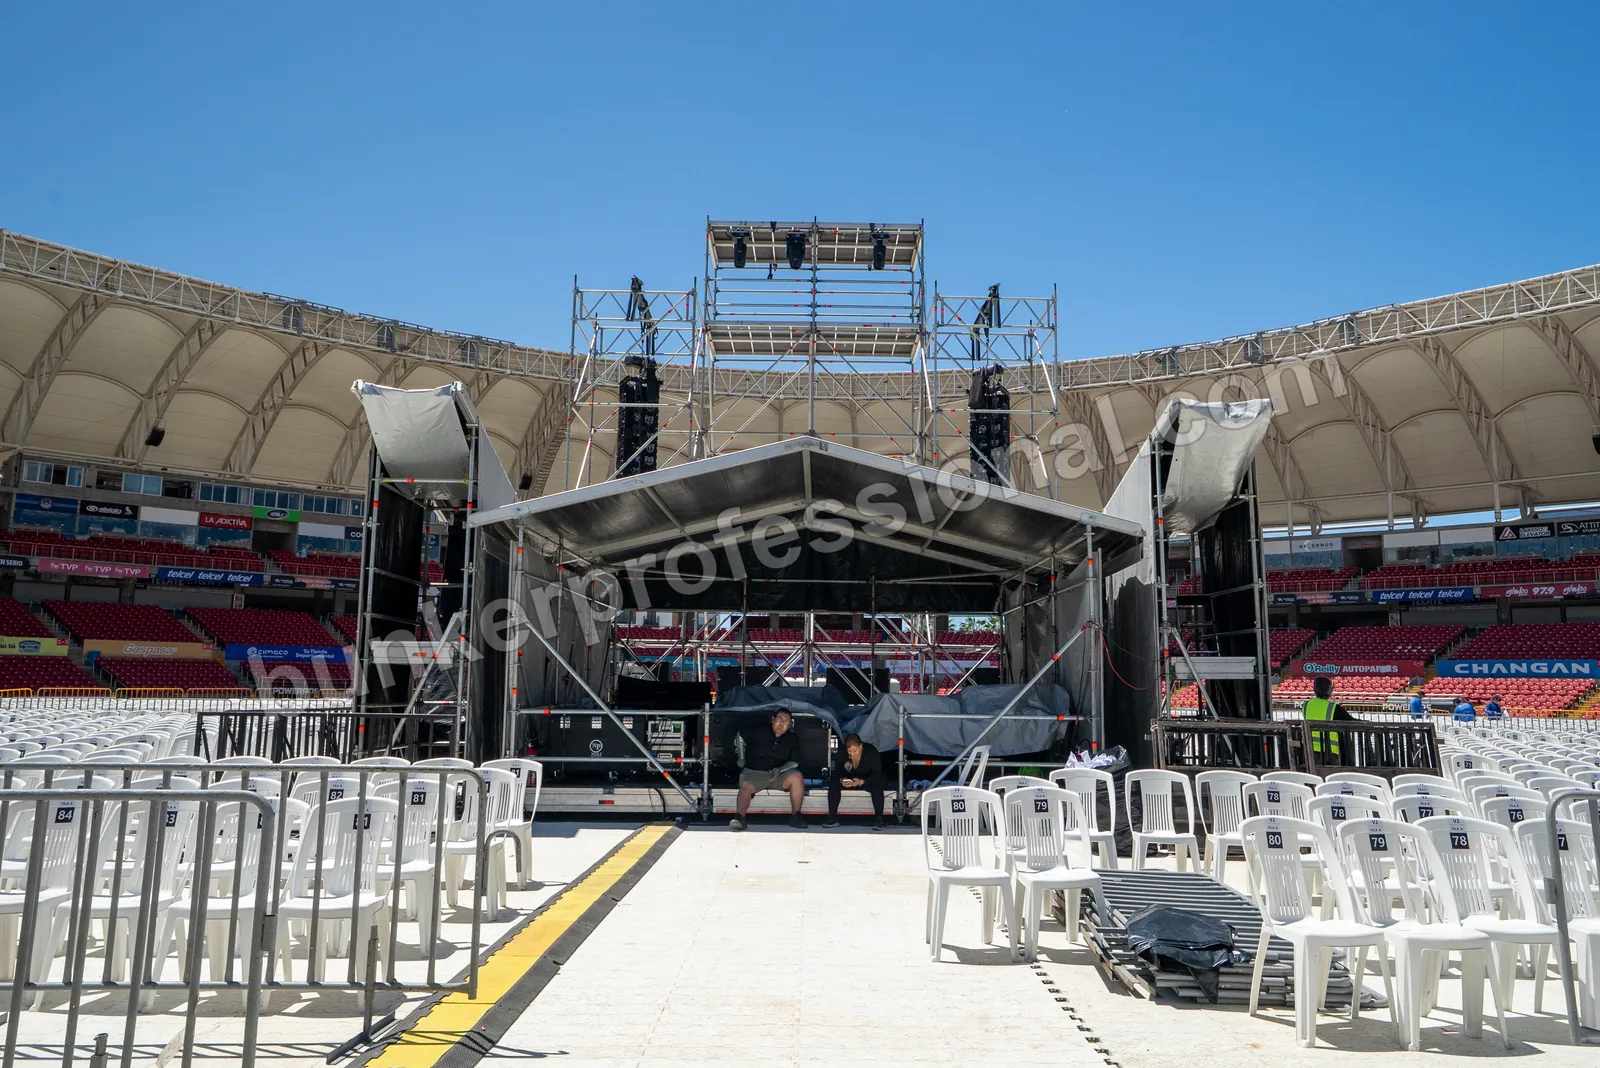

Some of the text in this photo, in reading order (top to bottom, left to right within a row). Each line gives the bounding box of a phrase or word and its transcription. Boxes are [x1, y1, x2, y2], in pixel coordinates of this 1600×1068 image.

[215, 517, 247, 529] ADICTIVA
[6, 559, 23, 568] SERIO
[61, 562, 78, 571] TVP
[94, 565, 111, 573] TVP
[124, 567, 141, 575] TVP
[167, 569, 253, 582] telcel telcel telcel
[1380, 589, 1465, 600] telcel telcel telcel
[1532, 586, 1555, 595] 97.9
[1342, 664, 1398, 674] AUTOPARS
[1454, 662, 1590, 674] CHANGAN
[1382, 703, 1432, 711] POWEDE
[330, 791, 343, 801] 82
[412, 794, 426, 804] 81
[1268, 792, 1280, 802] 78
[952, 800, 965, 811] 80
[1035, 801, 1048, 811] 79
[57, 809, 73, 821] 84
[1332, 808, 1345, 818] 78
[1510, 810, 1524, 821] 76
[1268, 834, 1282, 846] 80
[1370, 837, 1386, 848] 79
[1452, 835, 1468, 847] 78
